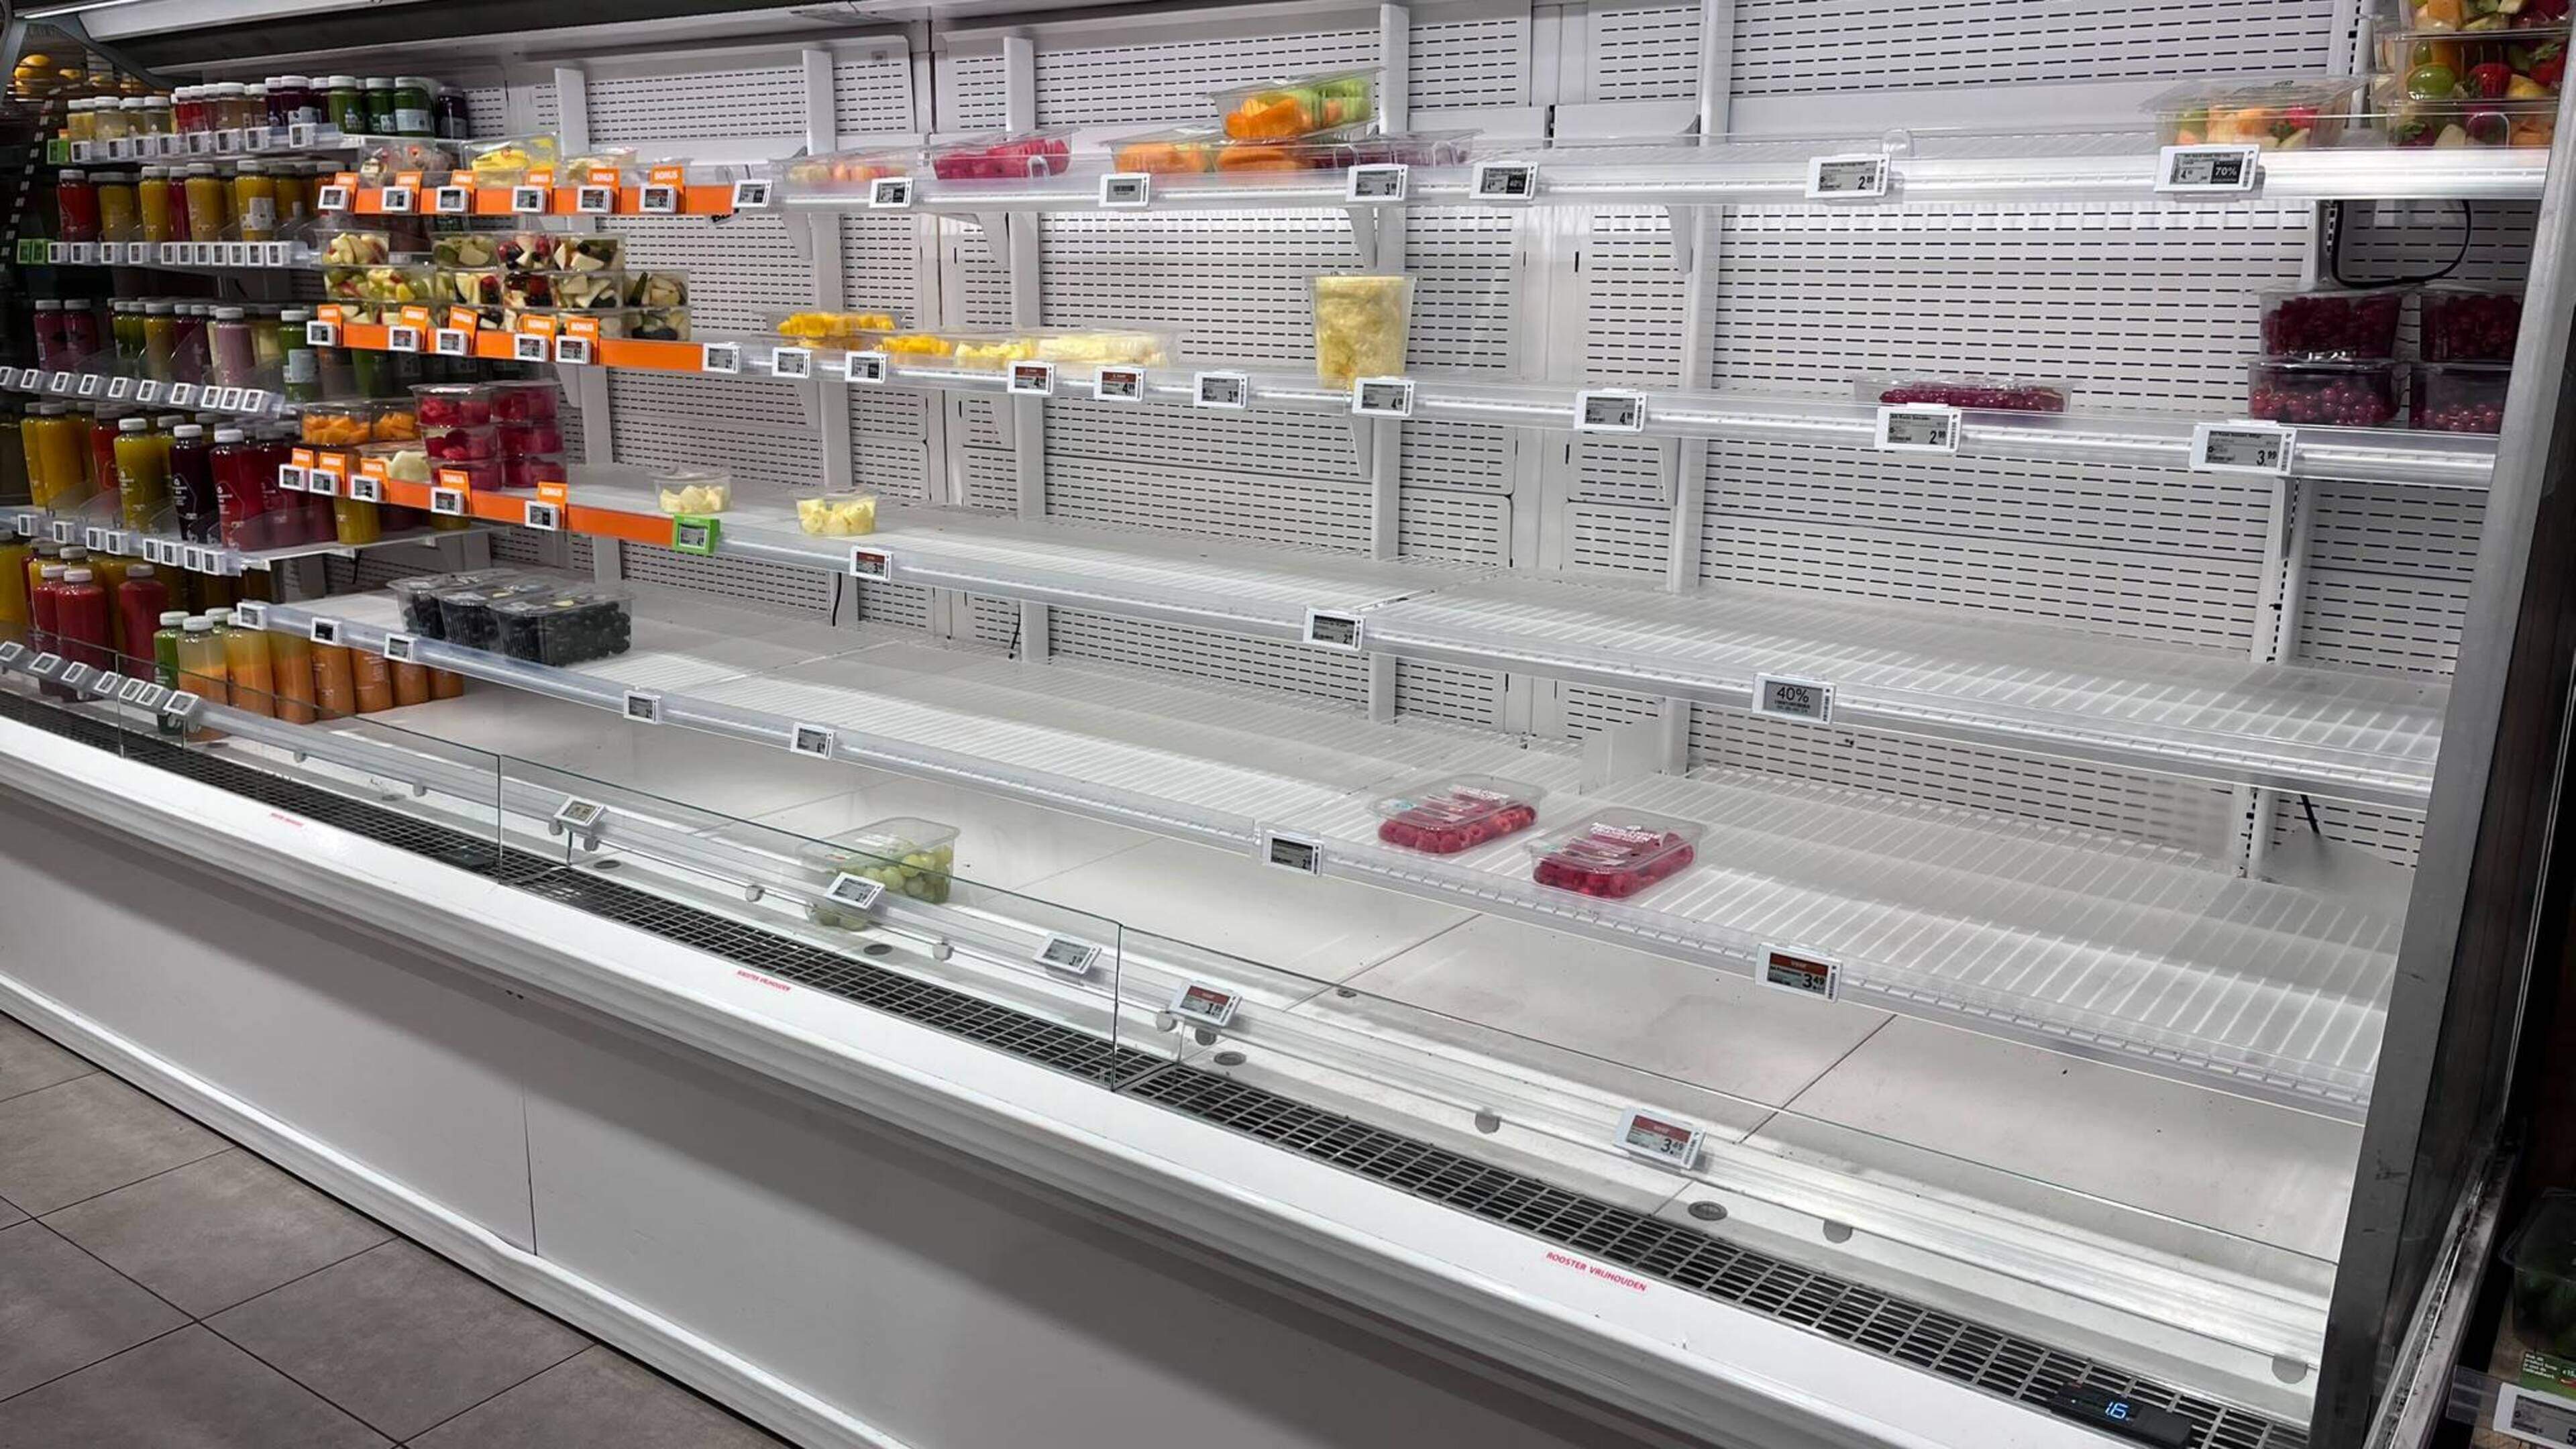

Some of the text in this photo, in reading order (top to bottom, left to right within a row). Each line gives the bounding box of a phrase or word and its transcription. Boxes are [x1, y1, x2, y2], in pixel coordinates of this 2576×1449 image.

[1776, 686, 1810, 703] 40%
[1546, 1252, 1647, 1291] ROOSTER VRIJHOUDEN
